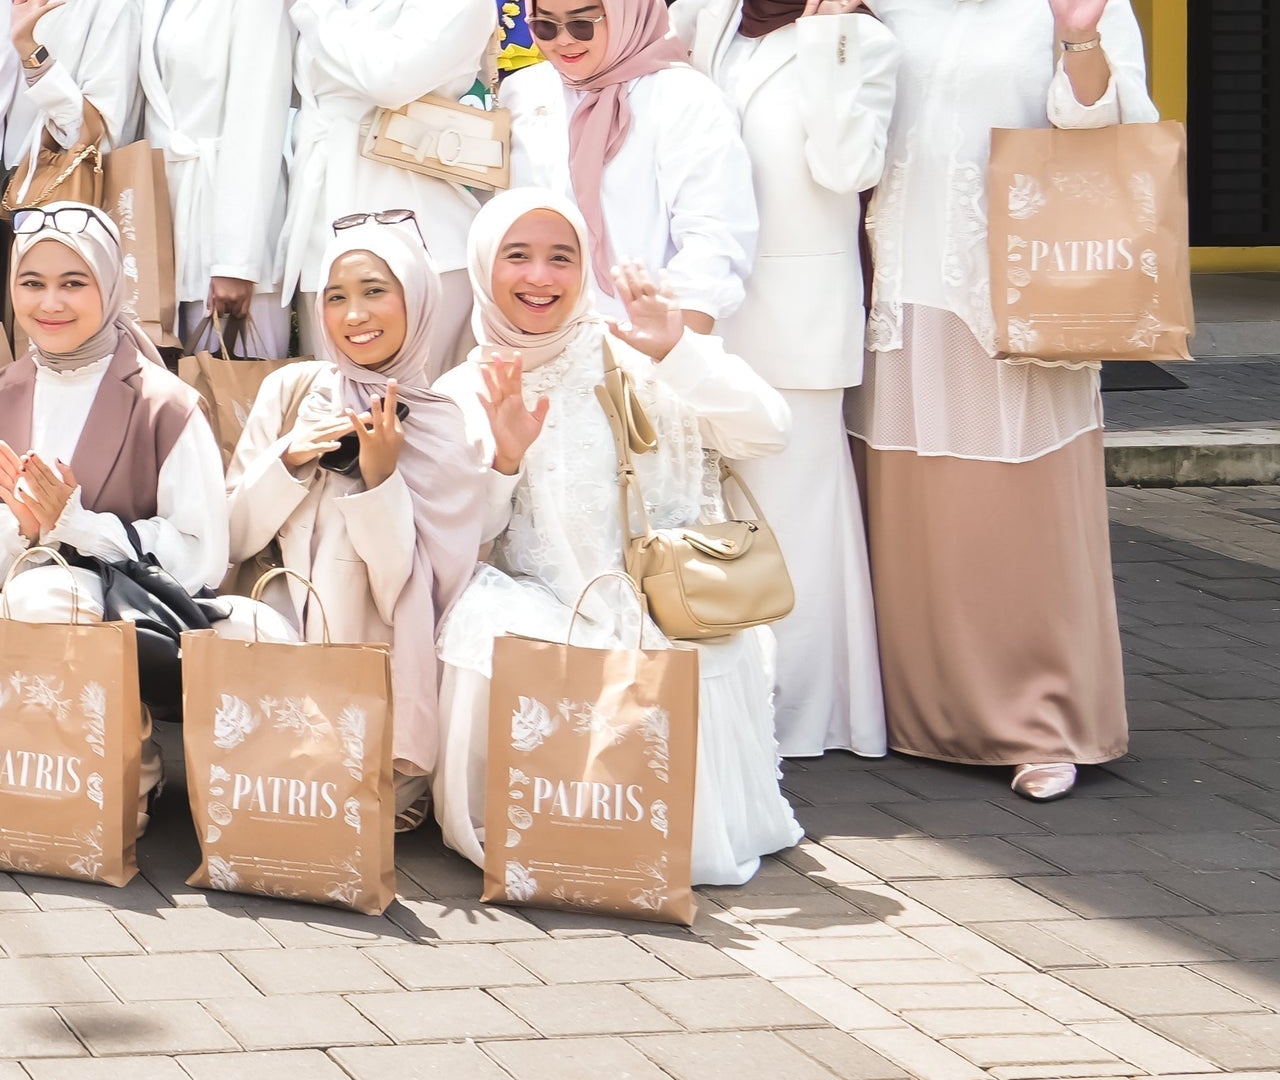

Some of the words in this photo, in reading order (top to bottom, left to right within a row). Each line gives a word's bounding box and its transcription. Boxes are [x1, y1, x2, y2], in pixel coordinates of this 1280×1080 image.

[1029, 237, 1135, 272] PATRIS
[231, 773, 339, 820] PATRIS
[531, 776, 645, 822] PATRIS
